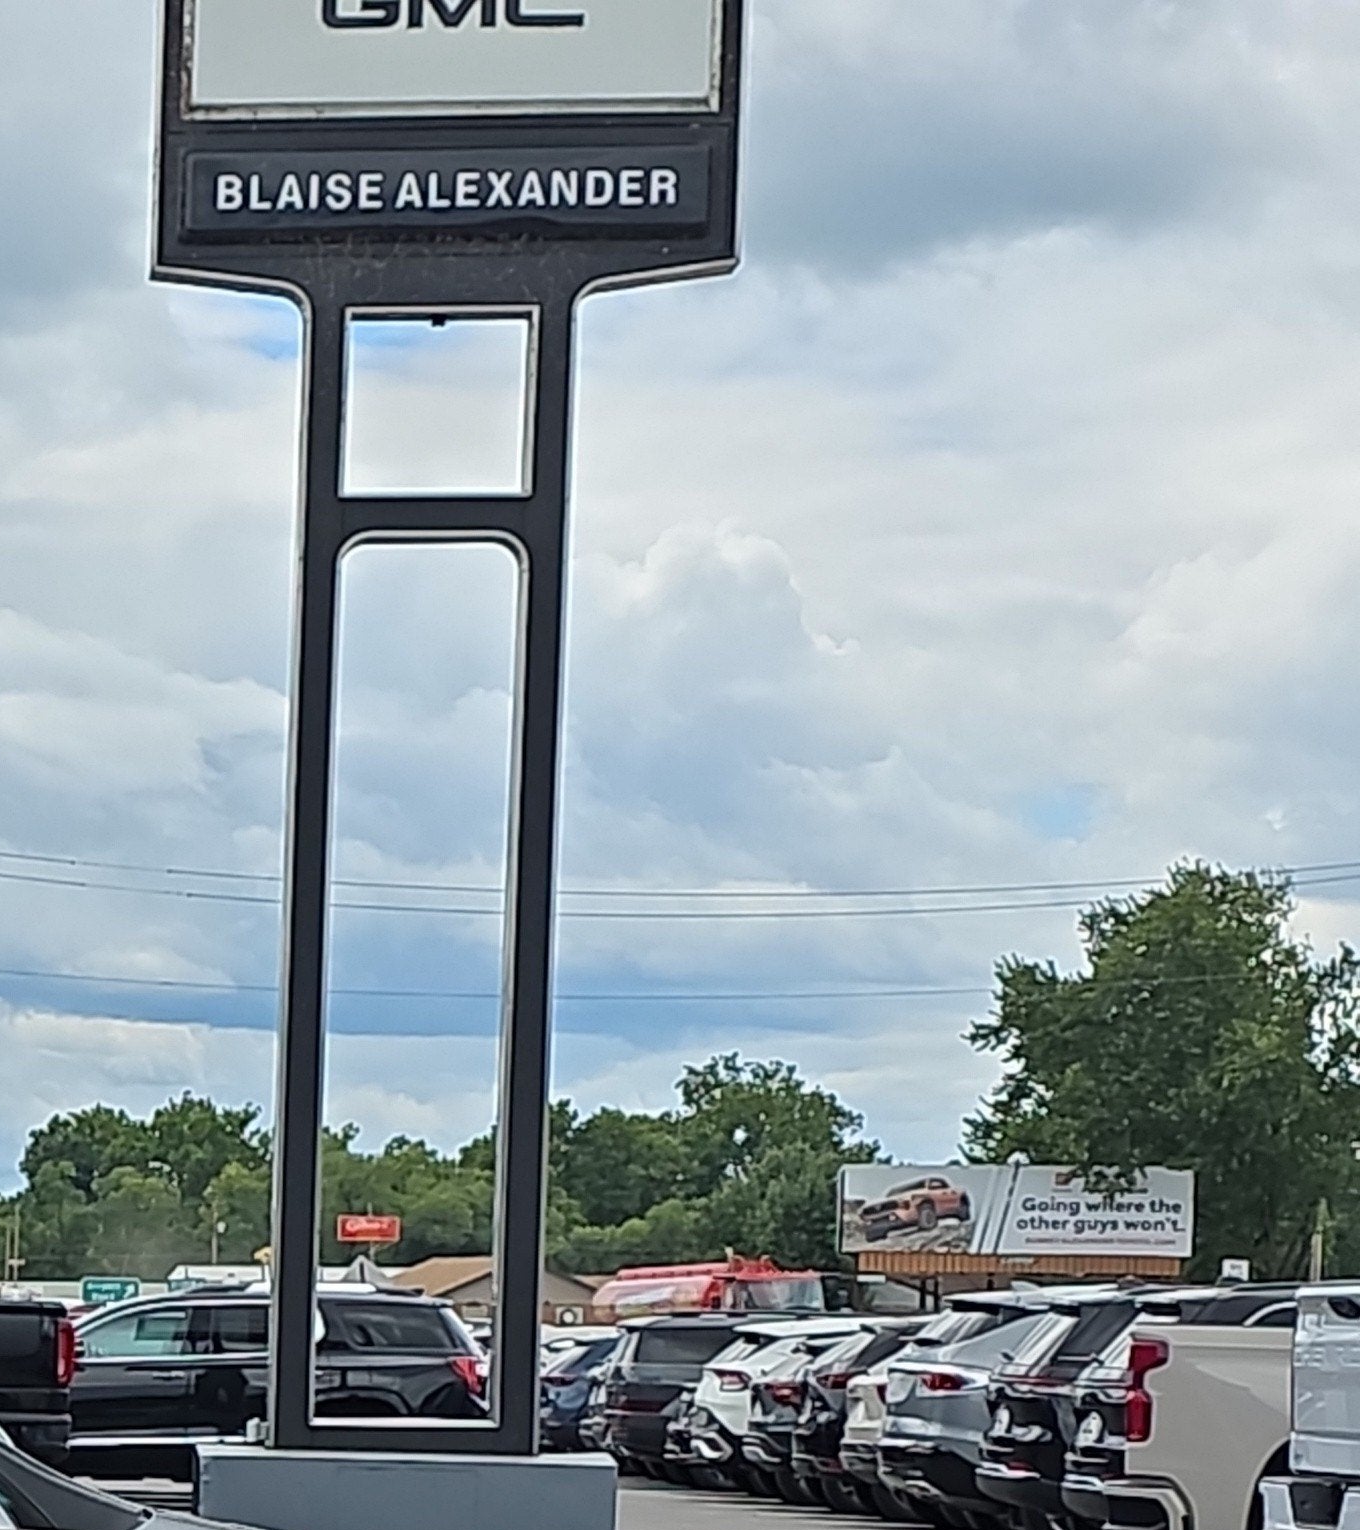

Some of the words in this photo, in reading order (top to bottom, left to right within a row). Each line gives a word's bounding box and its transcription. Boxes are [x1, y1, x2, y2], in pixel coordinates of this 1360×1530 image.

[322, 0, 586, 28] GMC
[214, 172, 384, 212] BLAISE
[394, 167, 679, 211] ALEXANDER
[1021, 1196, 1081, 1216] Going
[1149, 1197, 1183, 1214] the
[1016, 1215, 1070, 1231] other
[1073, 1218, 1119, 1235] guys
